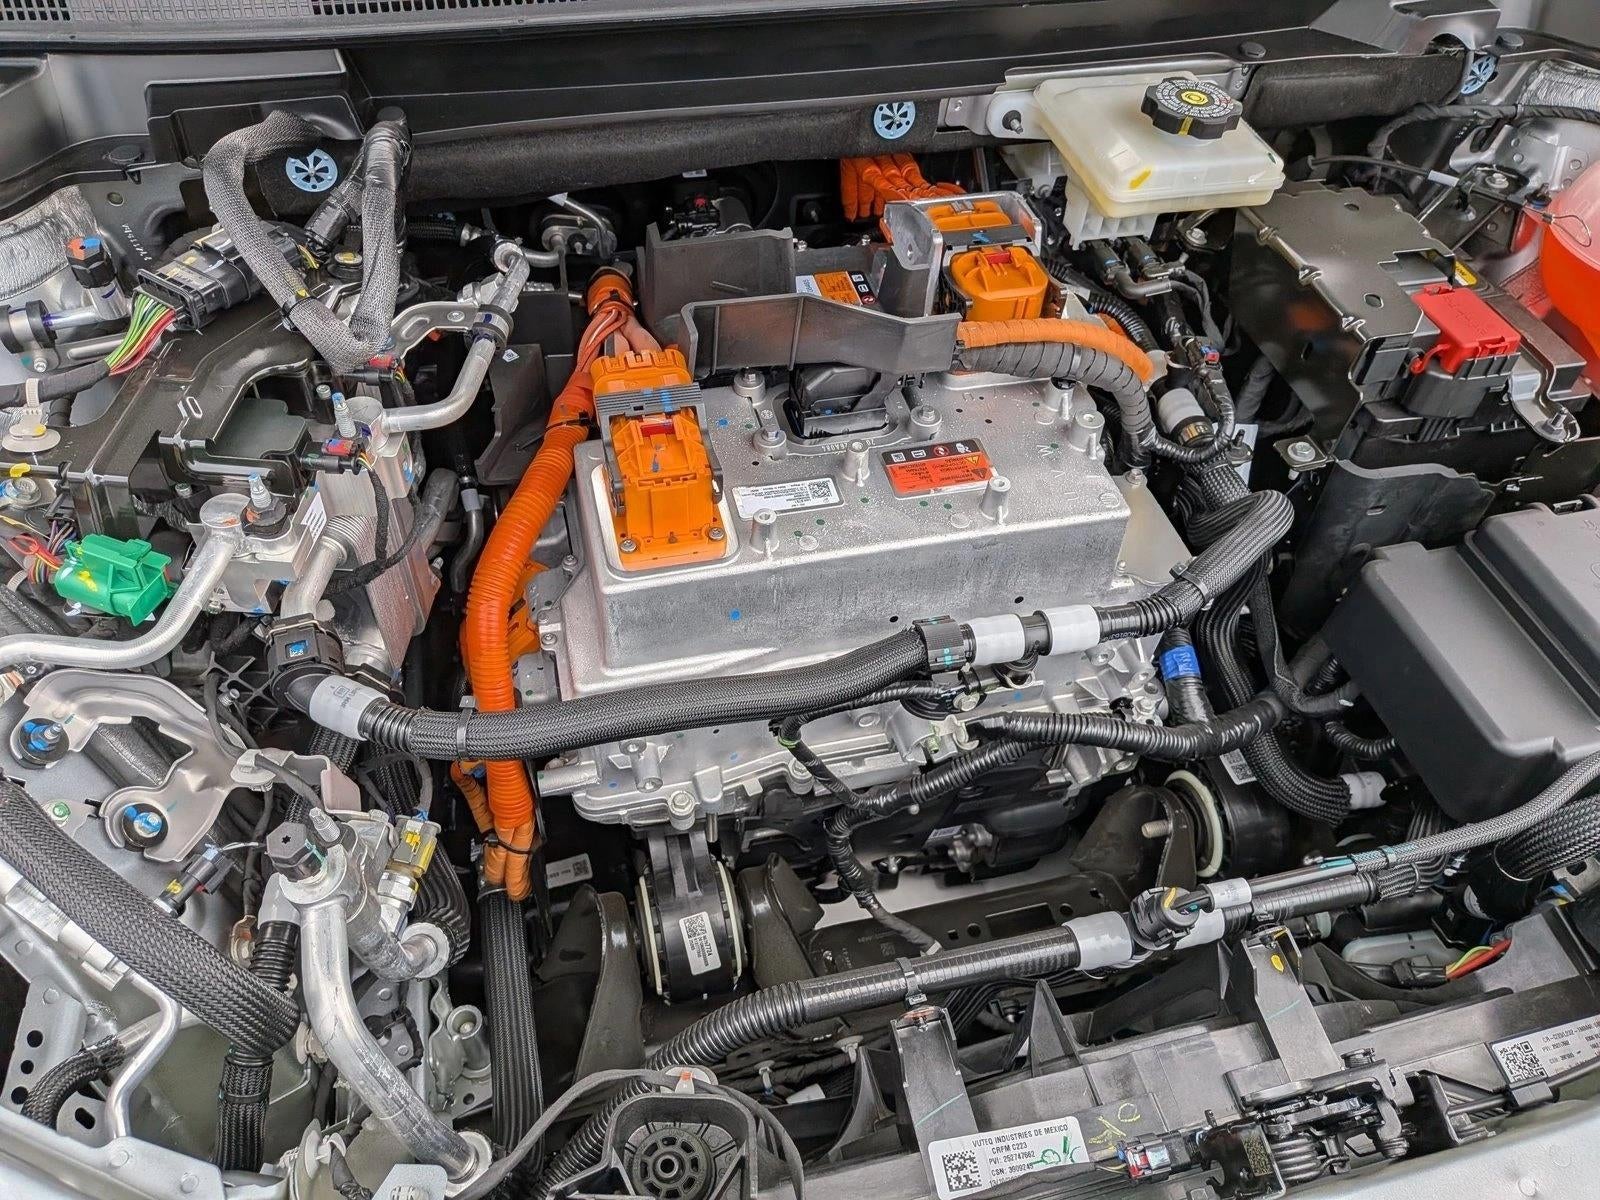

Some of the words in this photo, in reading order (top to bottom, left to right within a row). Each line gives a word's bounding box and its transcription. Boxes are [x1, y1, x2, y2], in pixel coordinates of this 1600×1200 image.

[994, 1130, 1033, 1144] INDUSTRIES
[1034, 1127, 1043, 1137] DE
[1043, 1123, 1069, 1135] MEXICO
[991, 1143, 1011, 1155] CRFM
[1011, 1141, 1028, 1151] C223
